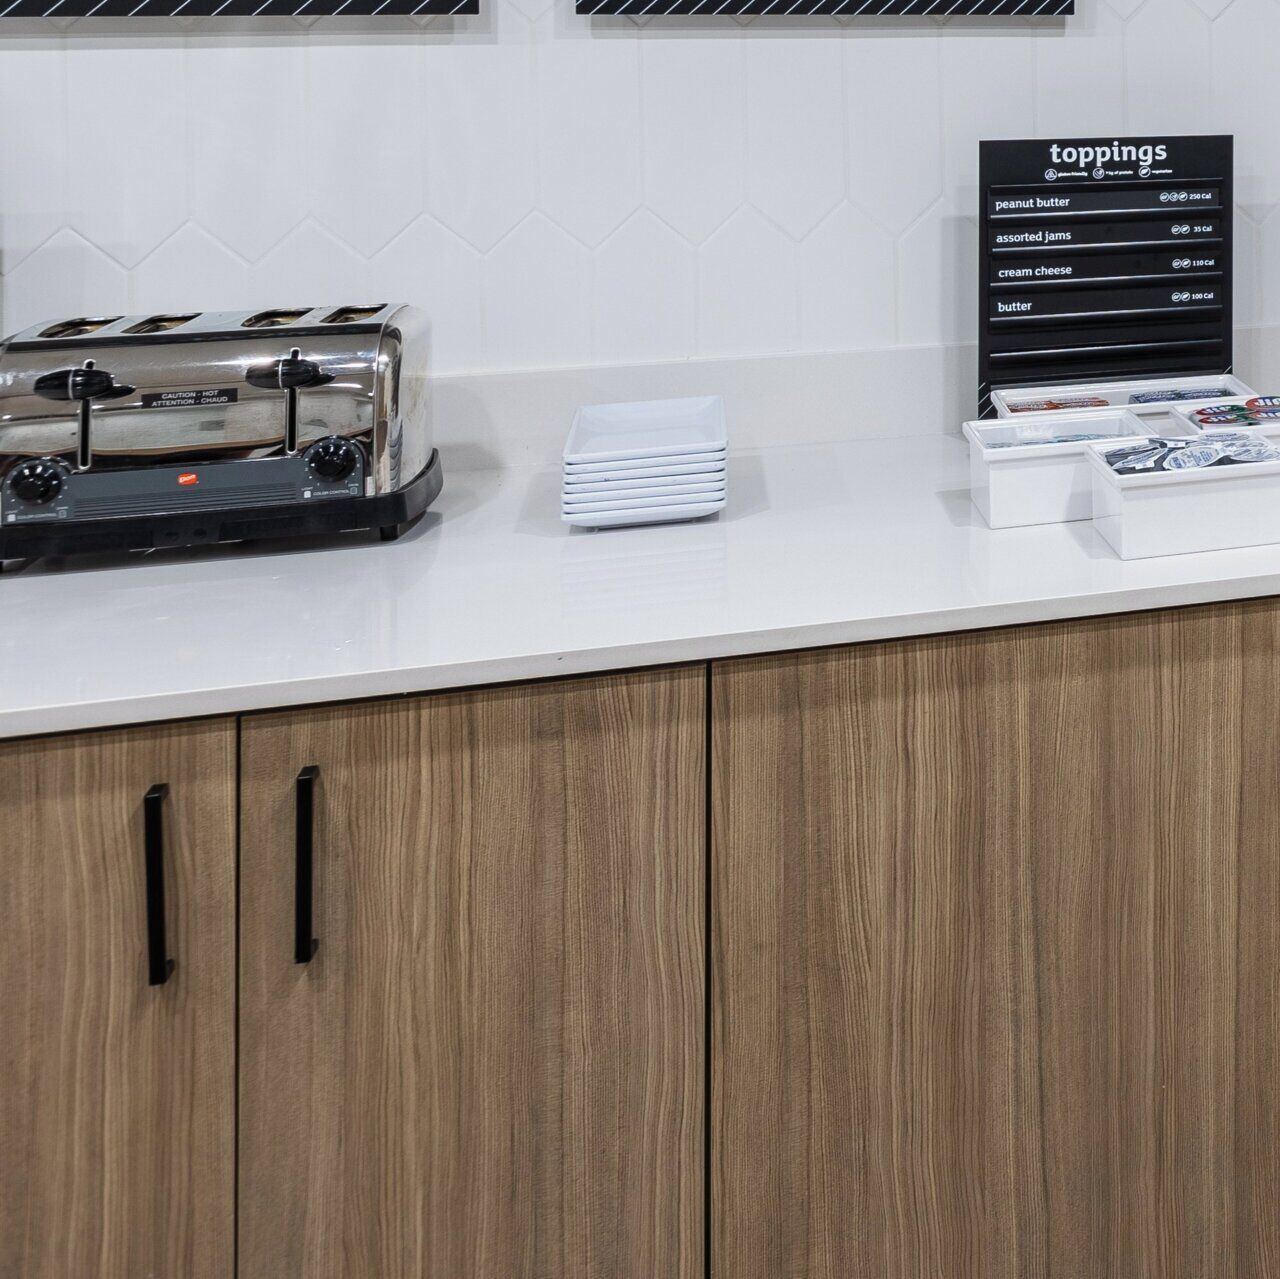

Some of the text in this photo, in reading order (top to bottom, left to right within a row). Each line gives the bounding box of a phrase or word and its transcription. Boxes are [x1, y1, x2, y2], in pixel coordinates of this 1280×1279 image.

[1049, 141, 1168, 168] toppings
[1201, 192, 1212, 200] Cal
[995, 197, 1070, 212] peanut butter
[995, 231, 1072, 244] assorted jams
[998, 265, 1073, 278] cream cheese
[997, 301, 1032, 313] butter
[161, 391, 196, 400] CAUTION
[202, 389, 220, 397] HOT
[151, 399, 195, 407] ATTENTION
[200, 396, 229, 404] CHAUD
